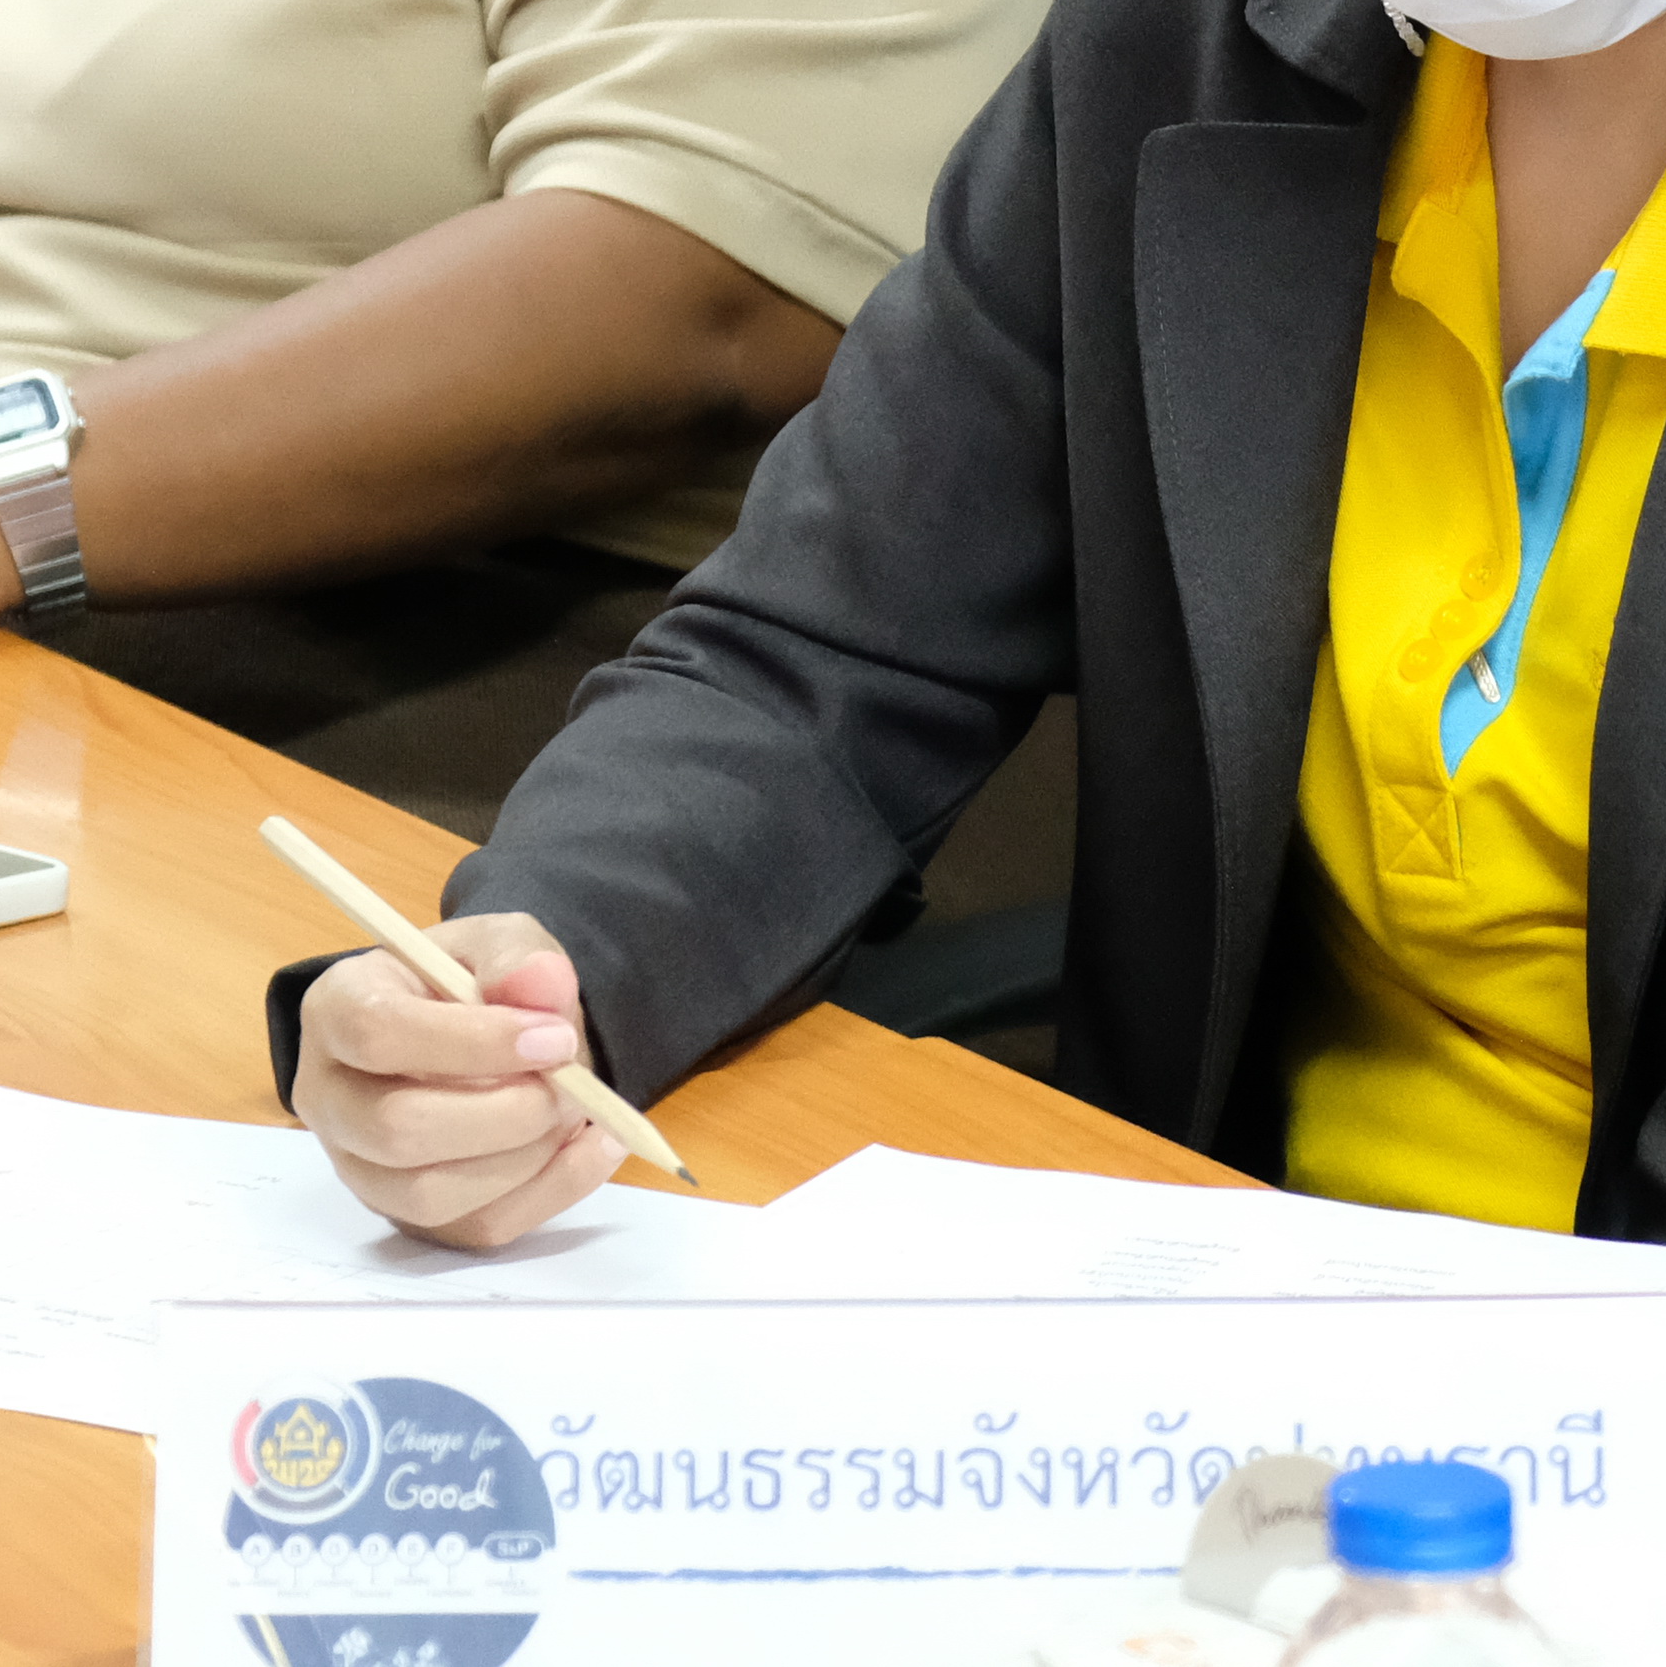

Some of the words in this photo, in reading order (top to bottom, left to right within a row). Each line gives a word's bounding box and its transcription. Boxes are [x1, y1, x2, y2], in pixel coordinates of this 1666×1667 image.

[383, 1417, 465, 1464] Change
[469, 1423, 502, 1462] for
[384, 1461, 498, 1512] Good
